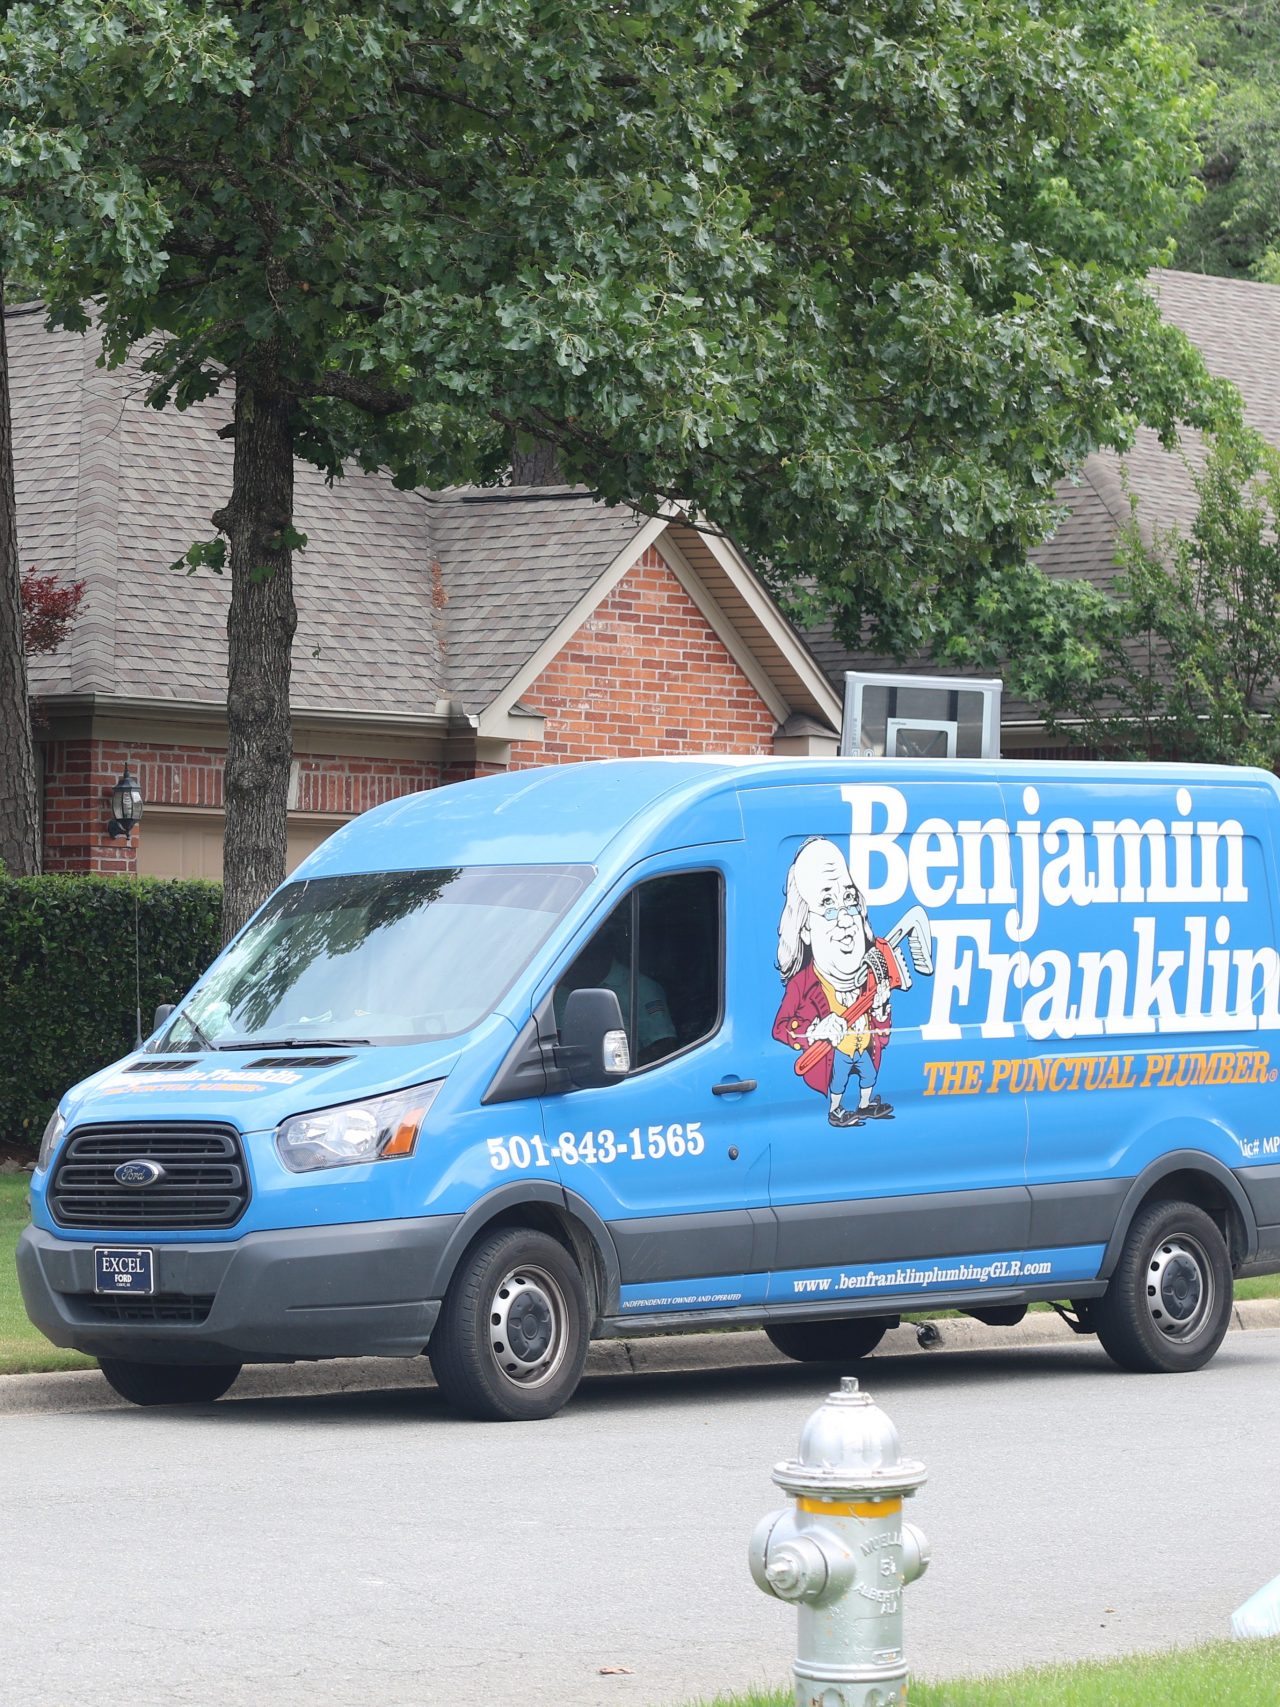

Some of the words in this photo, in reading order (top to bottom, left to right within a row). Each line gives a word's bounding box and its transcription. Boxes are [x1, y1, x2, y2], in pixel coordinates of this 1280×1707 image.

[841, 785, 1248, 942] Benjamin
[922, 915, 1280, 1041] Franklin
[923, 1060, 985, 1096] THE
[991, 1055, 1136, 1093] PUNCTUAL
[486, 1121, 705, 1171] 501-843-1565
[121, 1165, 146, 1180] Ford
[102, 1257, 145, 1273] EXCEL
[114, 1274, 132, 1283] FORD
[793, 1278, 832, 1293] www
[834, 1261, 1052, 1290] .benfranklinplumbingGLR.com
[671, 1296, 698, 1305] OWNED
[697, 1295, 712, 1303] AND
[711, 1293, 742, 1302] OPERATED
